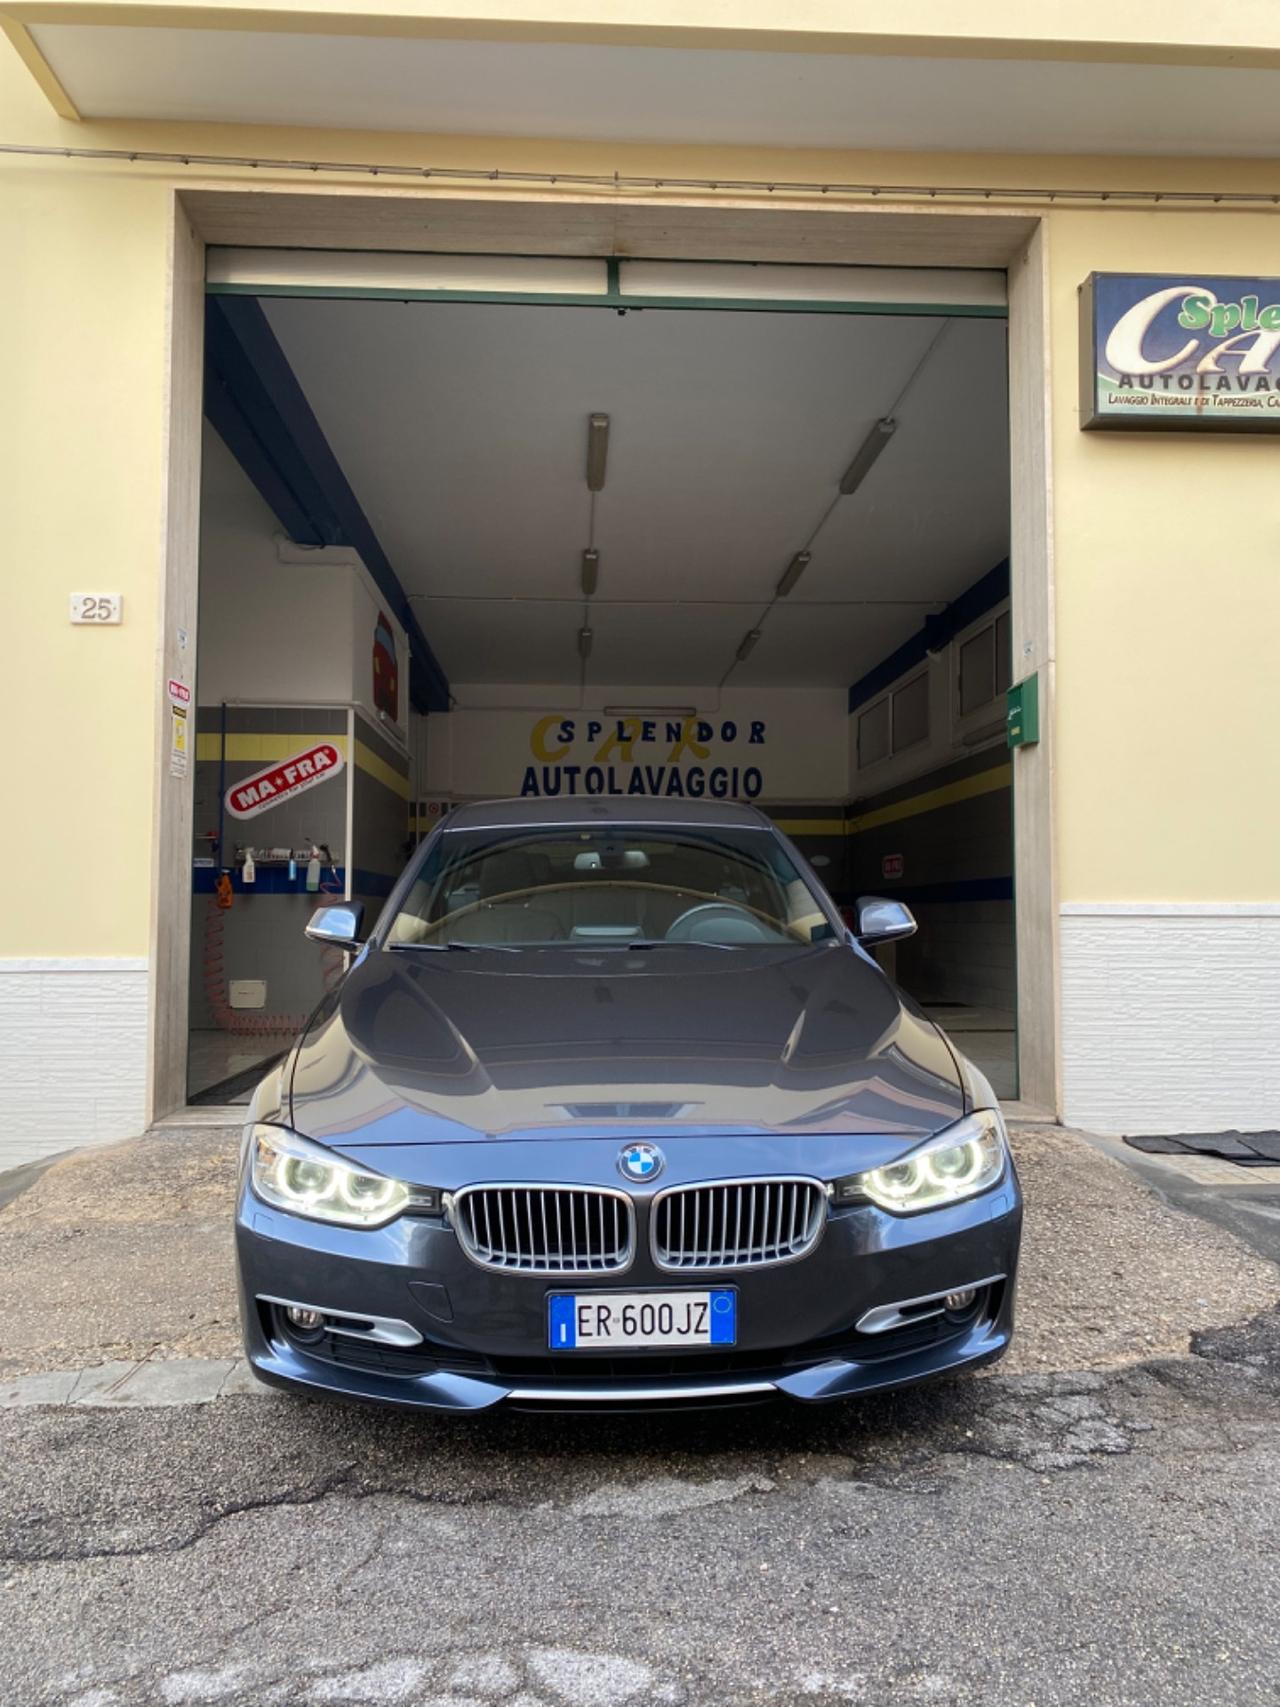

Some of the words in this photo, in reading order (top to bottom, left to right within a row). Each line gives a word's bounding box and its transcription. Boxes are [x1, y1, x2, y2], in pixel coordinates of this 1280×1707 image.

[81, 597, 112, 620] 25
[557, 720, 766, 744] SPLENDOR
[520, 766, 763, 798] AUTOLAVAGGIO
